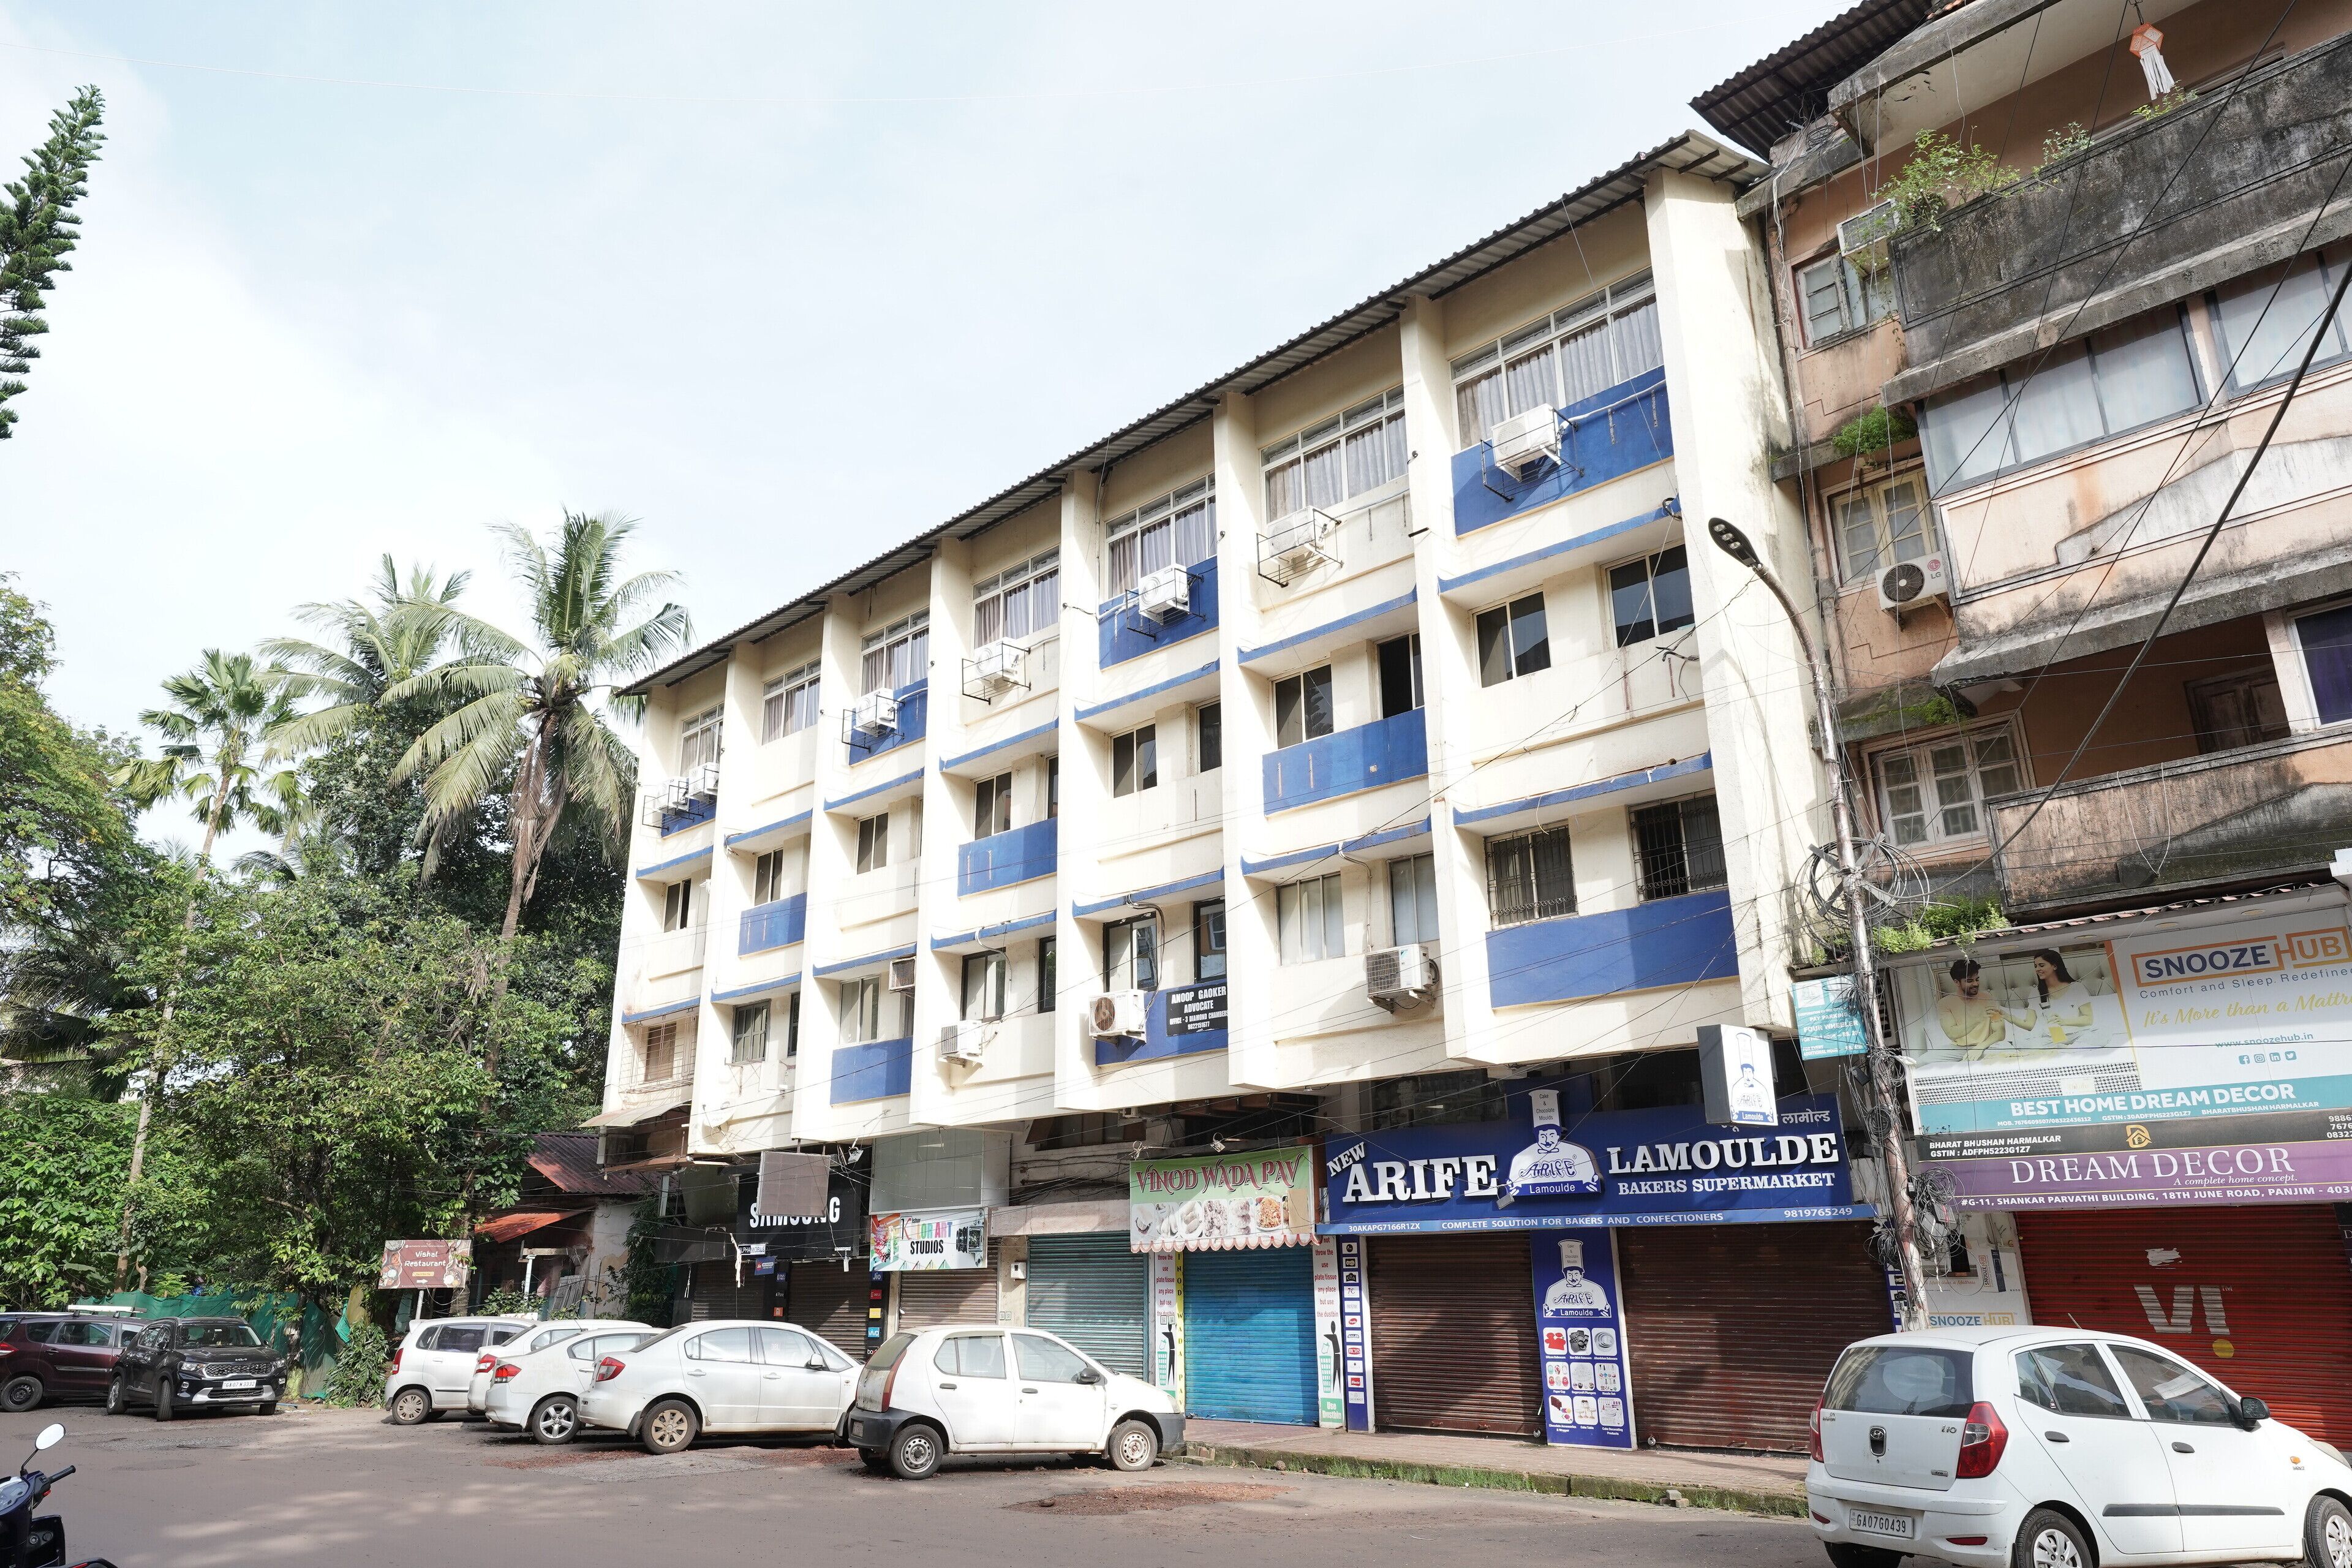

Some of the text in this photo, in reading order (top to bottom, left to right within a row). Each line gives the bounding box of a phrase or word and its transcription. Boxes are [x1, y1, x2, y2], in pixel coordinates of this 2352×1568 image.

[2145, 936, 2343, 979] SNOOZE HUB
[1171, 986, 1227, 1005] ANOOP GAOKER
[2139, 985, 2195, 999] Comfort
[2201, 980, 2225, 992] and
[1183, 1000, 1214, 1014] ADVOCATE
[2144, 1010, 2169, 1028] It's
[2174, 1006, 2220, 1025] More
[2227, 1001, 2270, 1017] than
[2275, 1000, 2290, 1013] a
[1189, 1013, 1208, 1022] DIAMOND
[1822, 1012, 1850, 1020] PARKING
[1824, 1020, 1859, 1030] WHEELER
[2215, 1031, 2315, 1049] www.snoozehub.in
[2010, 1083, 2297, 1117] BEST HOME DREAM DECOR
[2269, 1101, 2320, 1111] HARMALKAR
[1741, 1112, 1764, 1121] Lamoulde
[1929, 1140, 1962, 1150] BHARAT
[1964, 1138, 2005, 1148] BHUSHAN
[2007, 1135, 2062, 1145] HARMALKAR
[1326, 1142, 1366, 1177] NEW
[1930, 1149, 1956, 1158] GSTIN
[1136, 1152, 1304, 1195] VINOD WADA PAV
[1342, 1133, 1839, 1203] ARIFE LAMOULDE
[2009, 1147, 2296, 1183] DREAM DECOR
[1529, 1183, 1576, 1194] Lamoulde
[1618, 1172, 1836, 1195] BAKERS SUPERMARKET
[2185, 1175, 2226, 1187] complete
[2228, 1174, 2255, 1183] home
[2257, 1174, 2298, 1186] concept.
[1961, 1185, 2352, 1207] #G-11, SHANKAR PARVATHI BUILDING, 18TH JUNE ROAD, PANJIM 403
[1441, 1221, 1488, 1230] COMPLETE
[1491, 1219, 1539, 1228] SOLUTION
[1542, 1218, 1562, 1226] FOR
[1566, 1216, 1604, 1225] BAKERS
[1607, 1216, 1630, 1224] AND
[1636, 1213, 1724, 1224] CONFECTIONERS
[1784, 1207, 1853, 1218] 9819765249
[935, 1221, 953, 1238] ART
[910, 1239, 944, 1255] STUDIOS
[1930, 1316, 2011, 1326] SNOOZE HUB
[1322, 1410, 1342, 1419] Dustbin
[1941, 1425, 1957, 1434] i10
[1856, 1513, 1906, 1533] GA07G0439
